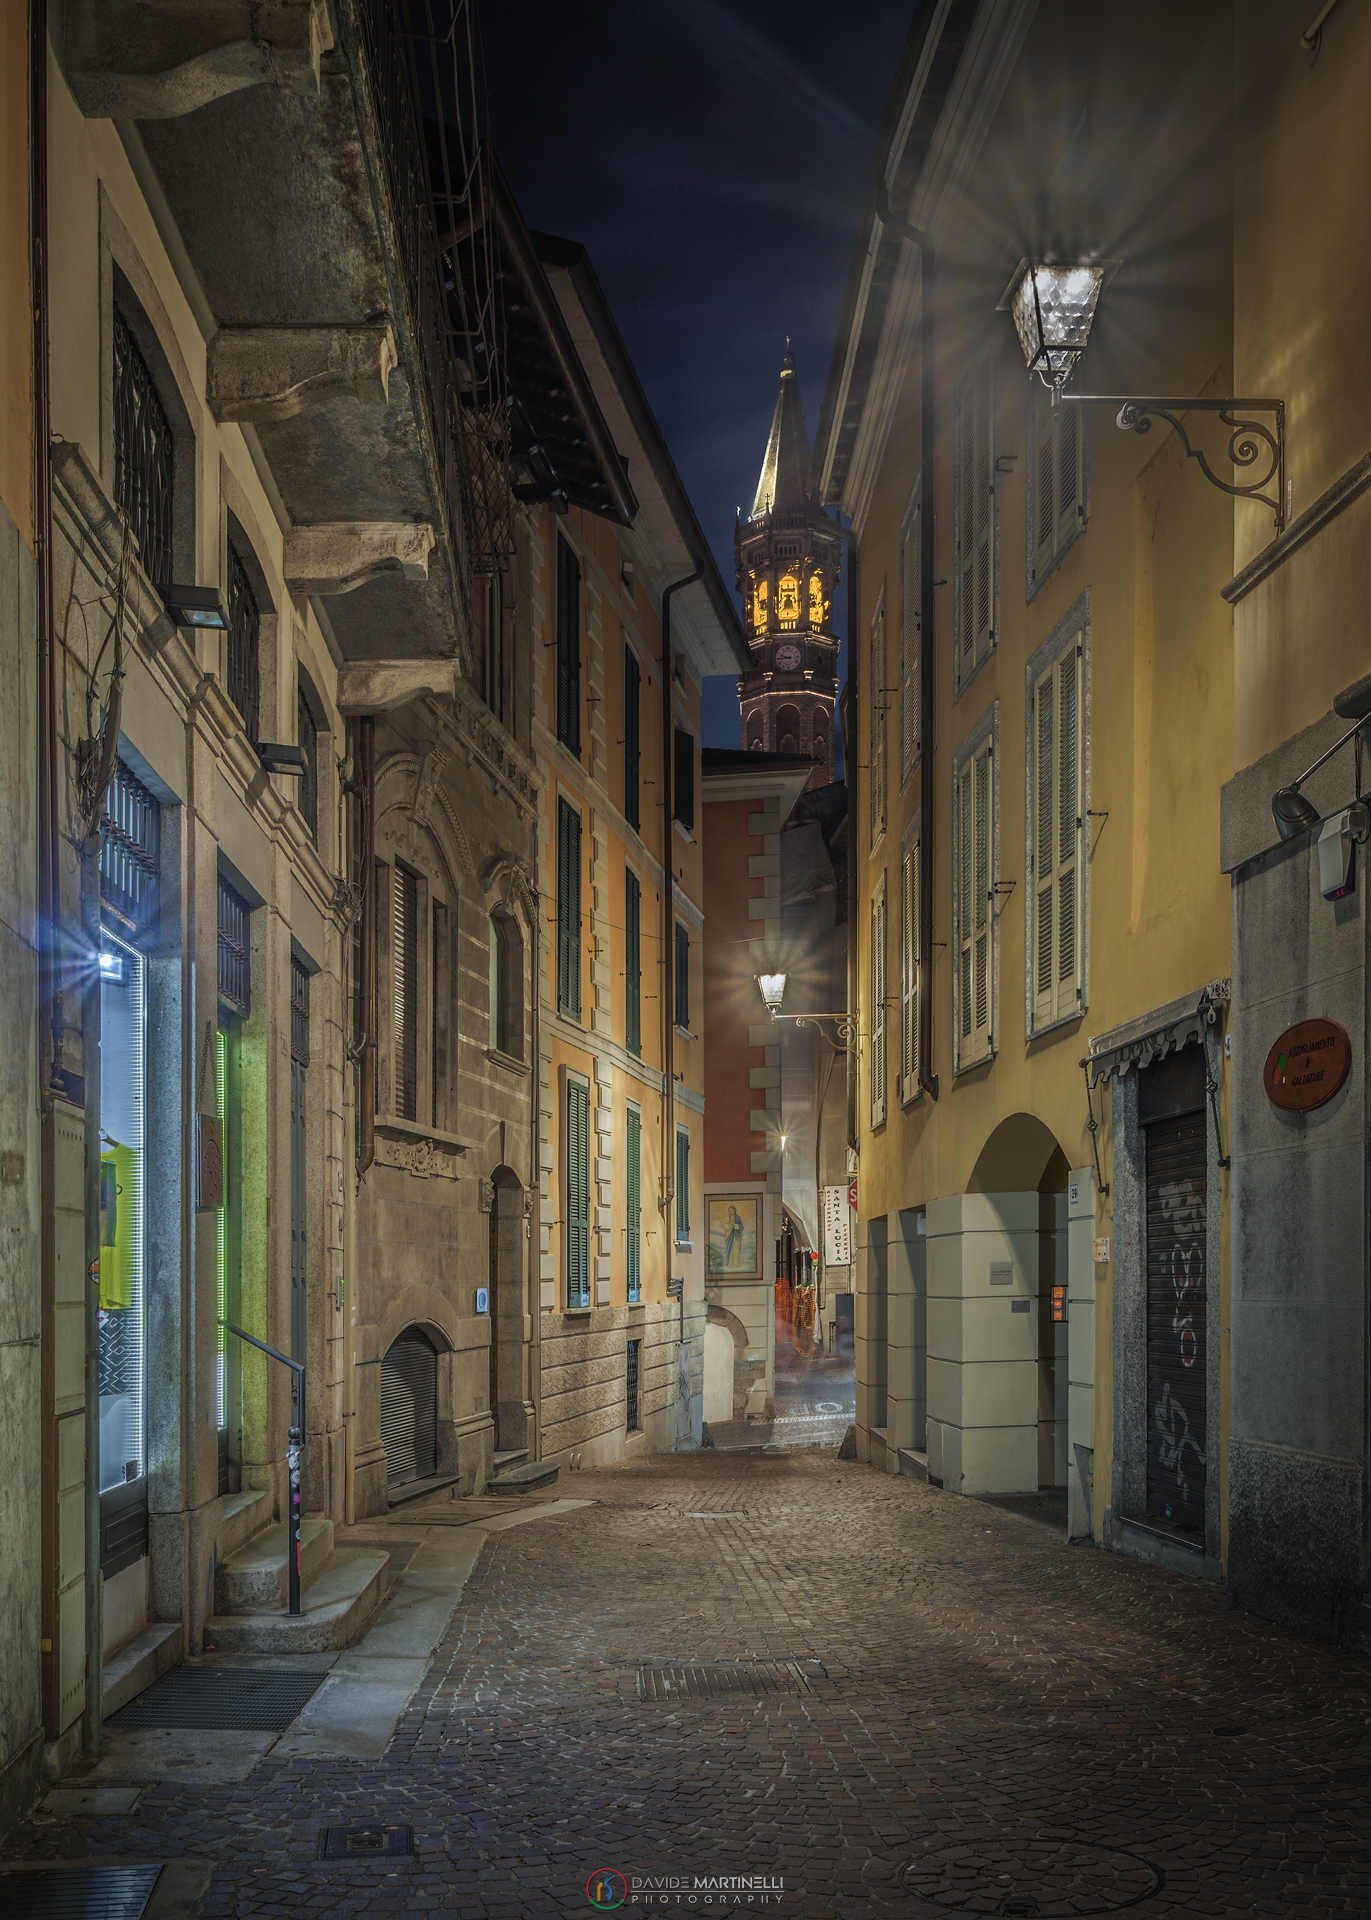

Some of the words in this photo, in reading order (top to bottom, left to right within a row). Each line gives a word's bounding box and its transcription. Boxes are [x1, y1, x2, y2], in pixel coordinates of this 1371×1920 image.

[1288, 1036, 1336, 1058] ABBIGLIAMENTO
[1292, 1070, 1325, 1087] CALZATURE
[833, 1189, 841, 1222] SANTA
[834, 1229, 842, 1261] LUCIA
